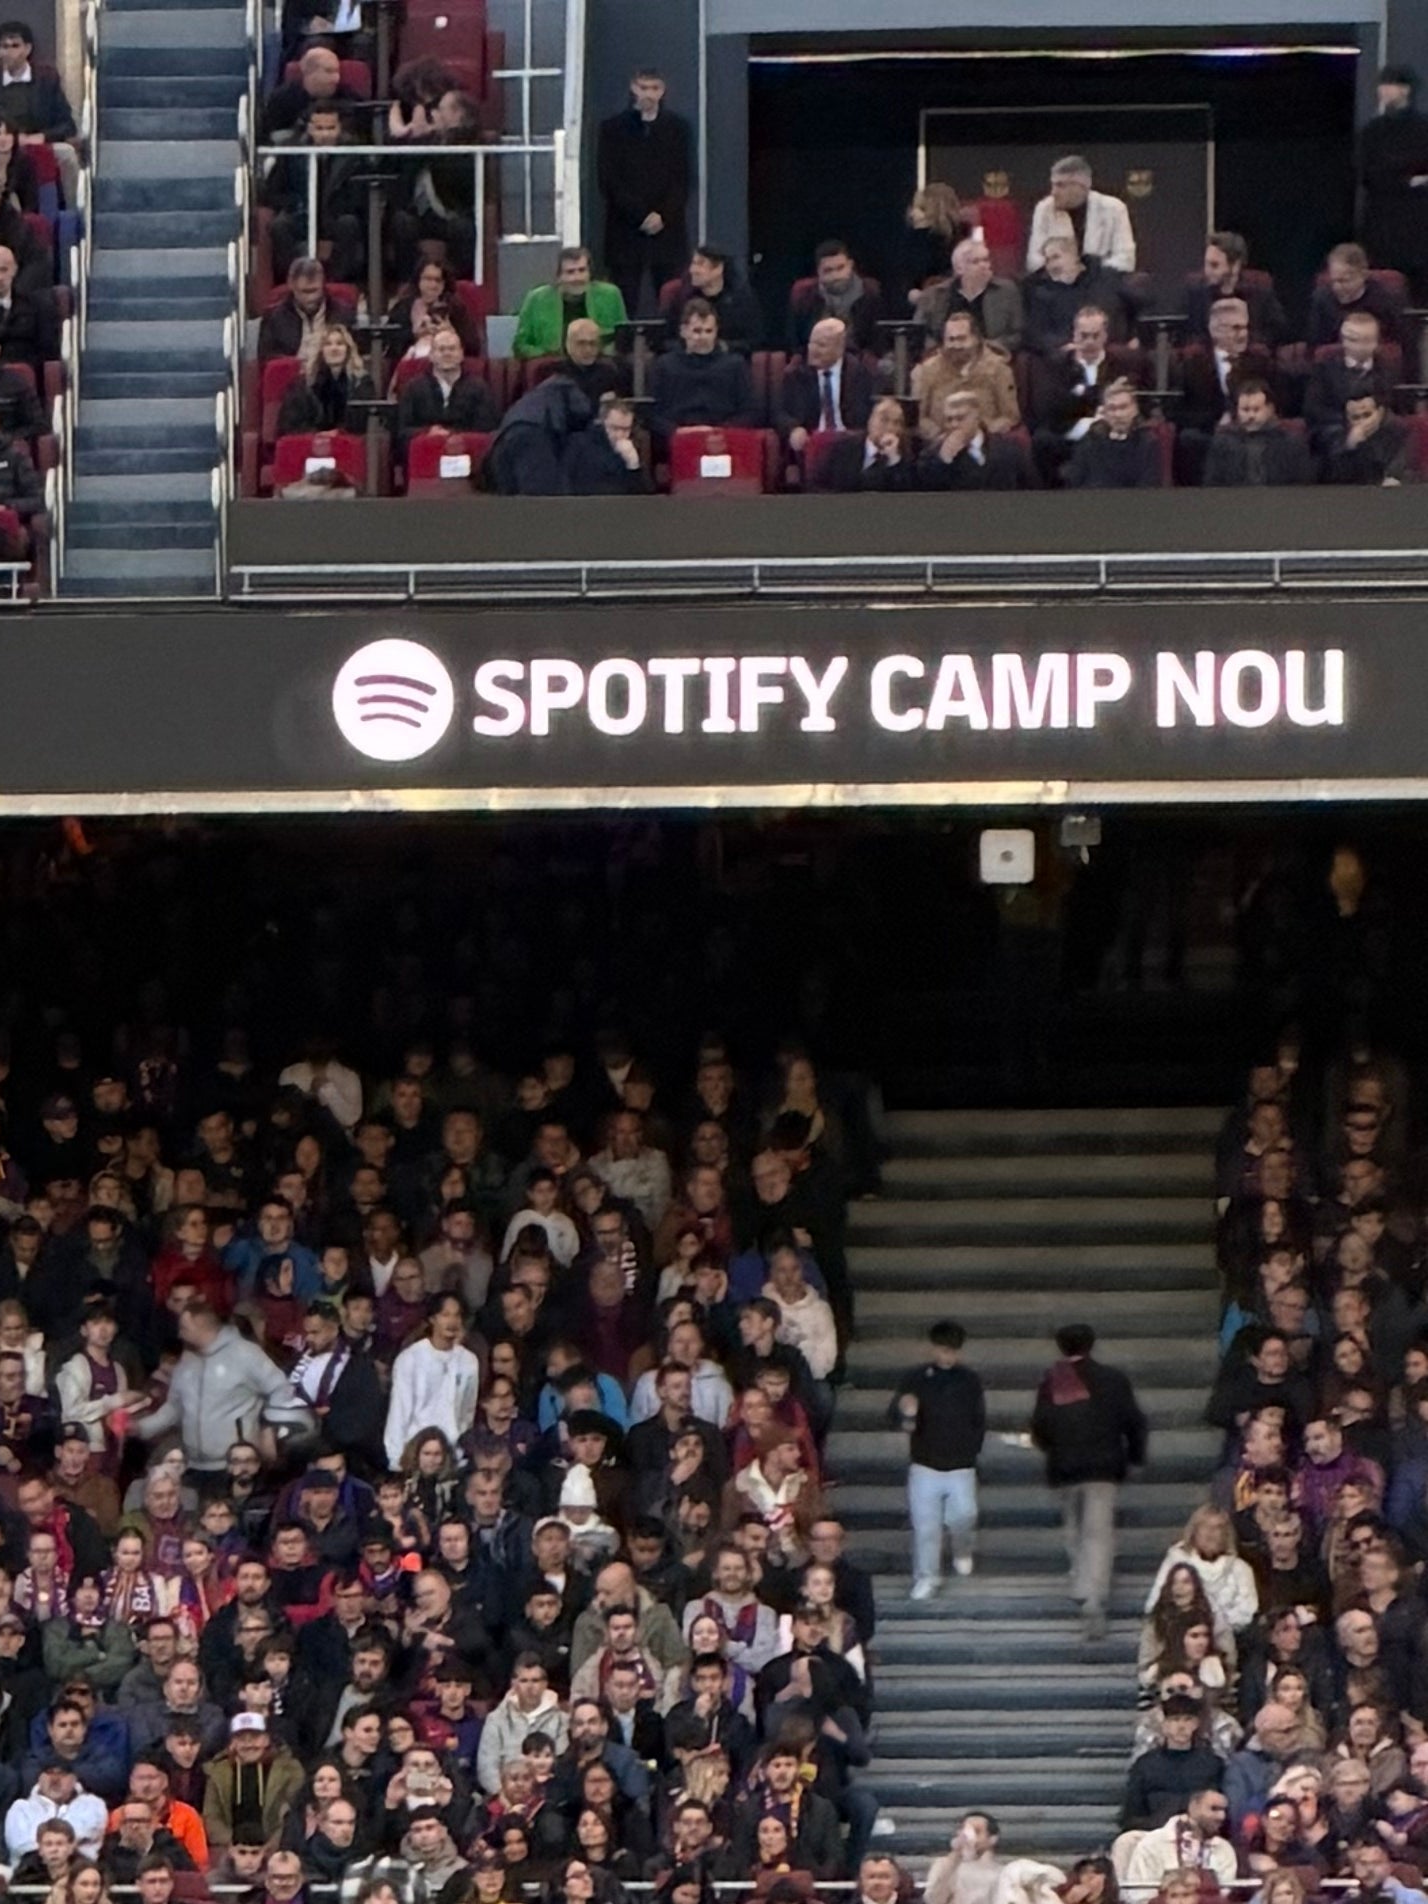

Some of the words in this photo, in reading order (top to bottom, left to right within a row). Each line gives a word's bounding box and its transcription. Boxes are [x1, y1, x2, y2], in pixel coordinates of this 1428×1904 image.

[474, 657, 848, 736] SPOTIFY
[871, 653, 1131, 731] CAMP
[1157, 650, 1343, 727] NOU
